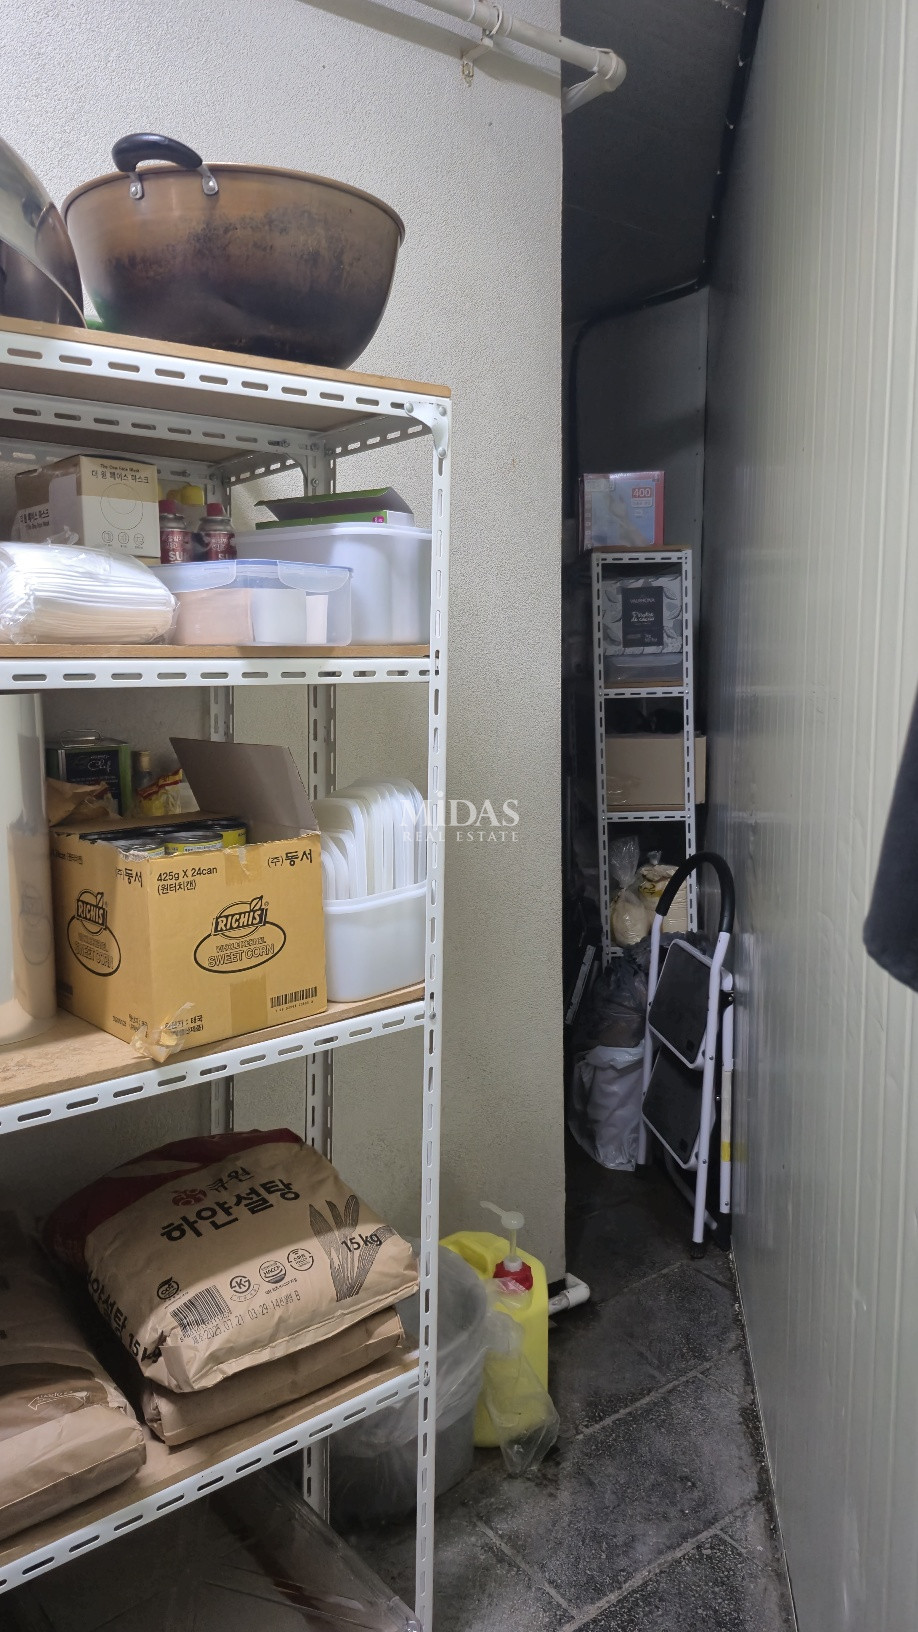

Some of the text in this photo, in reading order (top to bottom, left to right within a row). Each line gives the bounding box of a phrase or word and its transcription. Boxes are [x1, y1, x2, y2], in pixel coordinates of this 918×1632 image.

[110, 471, 128, 481] 페이스
[131, 474, 149, 484] 마스크
[633, 488, 651, 497] 400
[157, 871, 180, 882] 425g
[190, 866, 218, 877] 24can
[157, 880, 197, 895] (원터치캔)
[208, 943, 275, 967] SWEET CORN
[207, 1166, 254, 1193] 큐원
[160, 1178, 300, 1242] 하얀설탕
